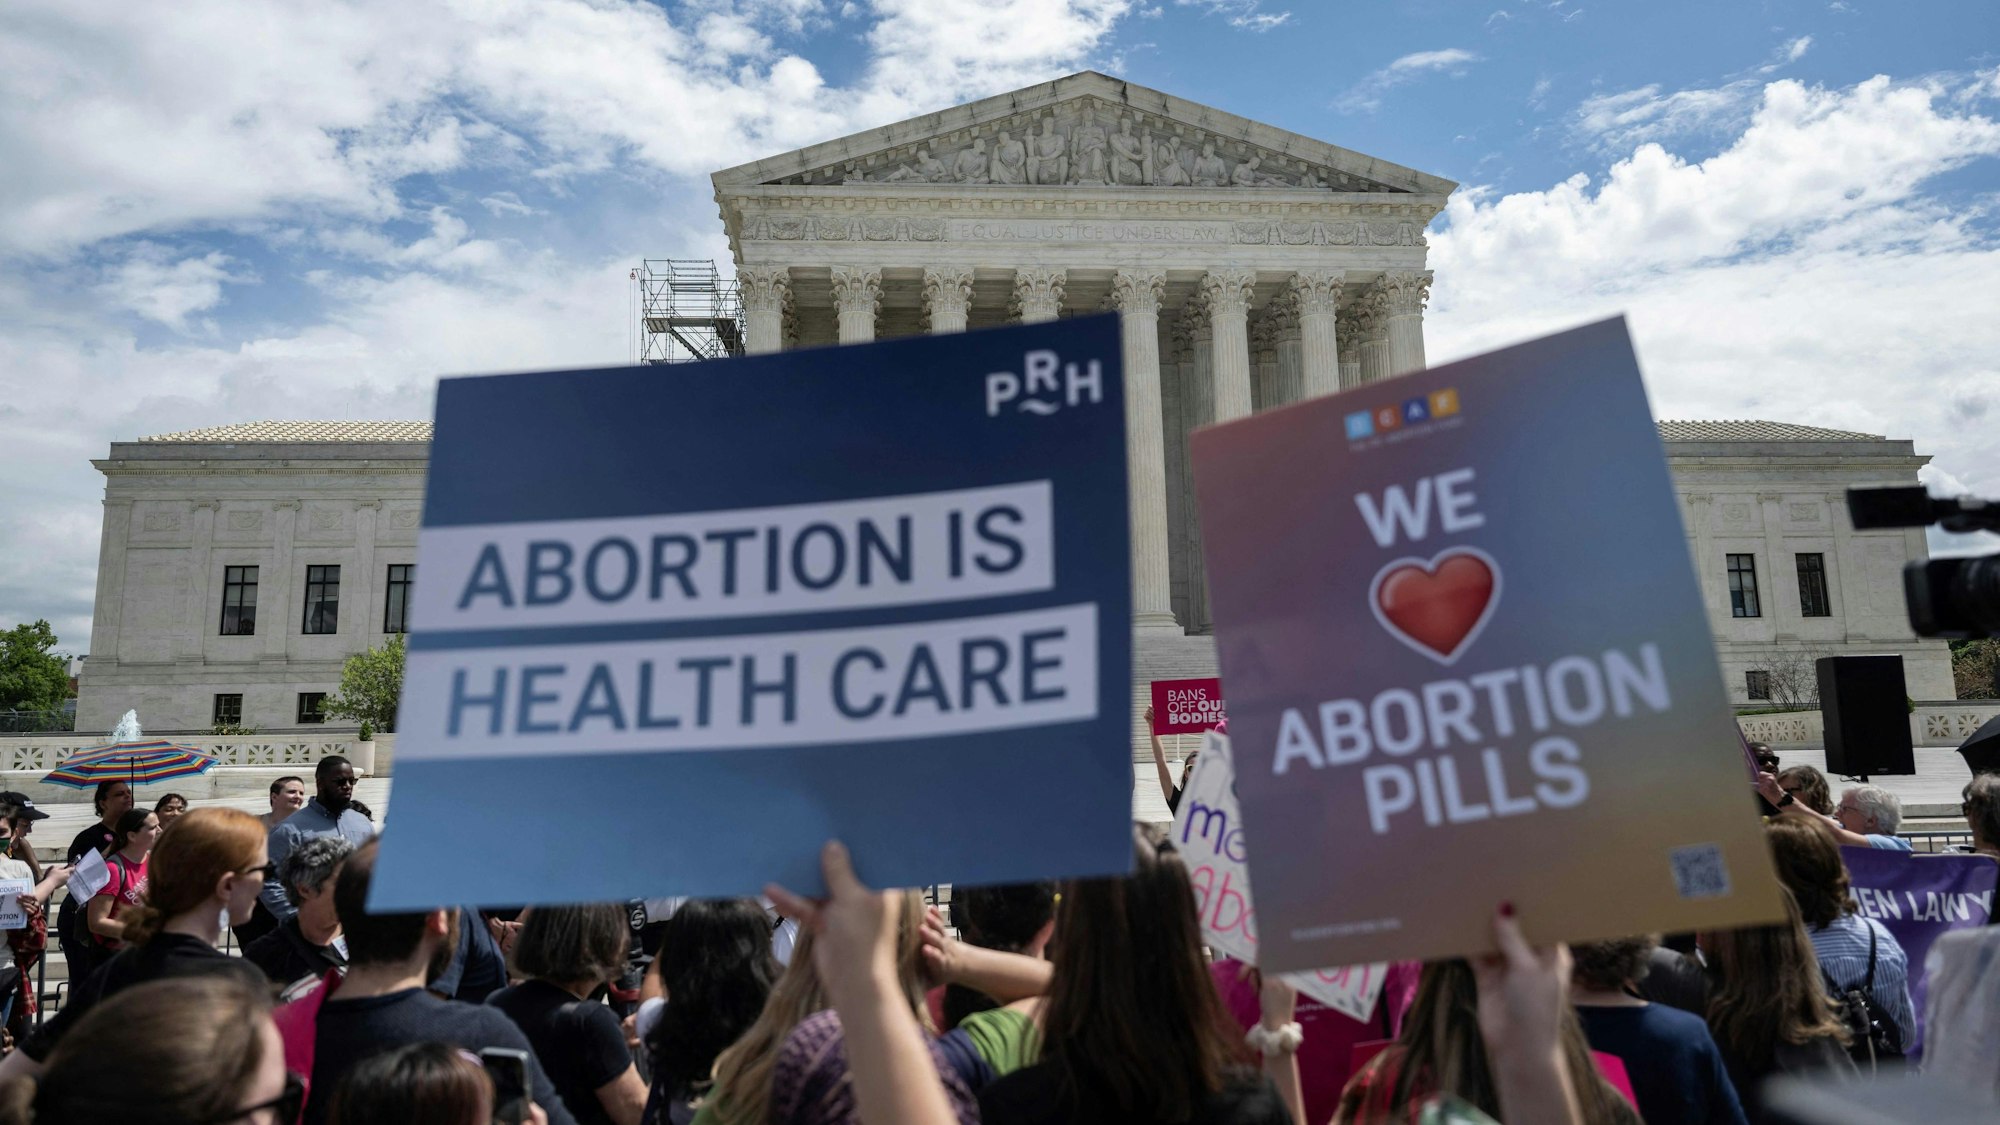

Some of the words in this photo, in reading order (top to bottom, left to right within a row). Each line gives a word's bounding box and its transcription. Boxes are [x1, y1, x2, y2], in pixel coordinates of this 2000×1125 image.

[961, 224, 1024, 239] EQUAL
[1030, 224, 1103, 240] JUSTICE
[1112, 225, 1176, 241] UNDER
[1181, 227, 1218, 241] LAW
[985, 349, 1103, 418] PRH
[1354, 466, 1487, 549] WE
[455, 513, 914, 612] ABORTION
[948, 504, 1026, 581] IS
[445, 652, 798, 739] HEALTH
[831, 627, 1068, 722] CARE
[1167, 688, 1207, 702] BANS
[1167, 701, 1196, 713] OFF
[1168, 711, 1227, 725] BODIES
[1272, 642, 1672, 775] ABORTION
[1362, 735, 1591, 834] PILLS
